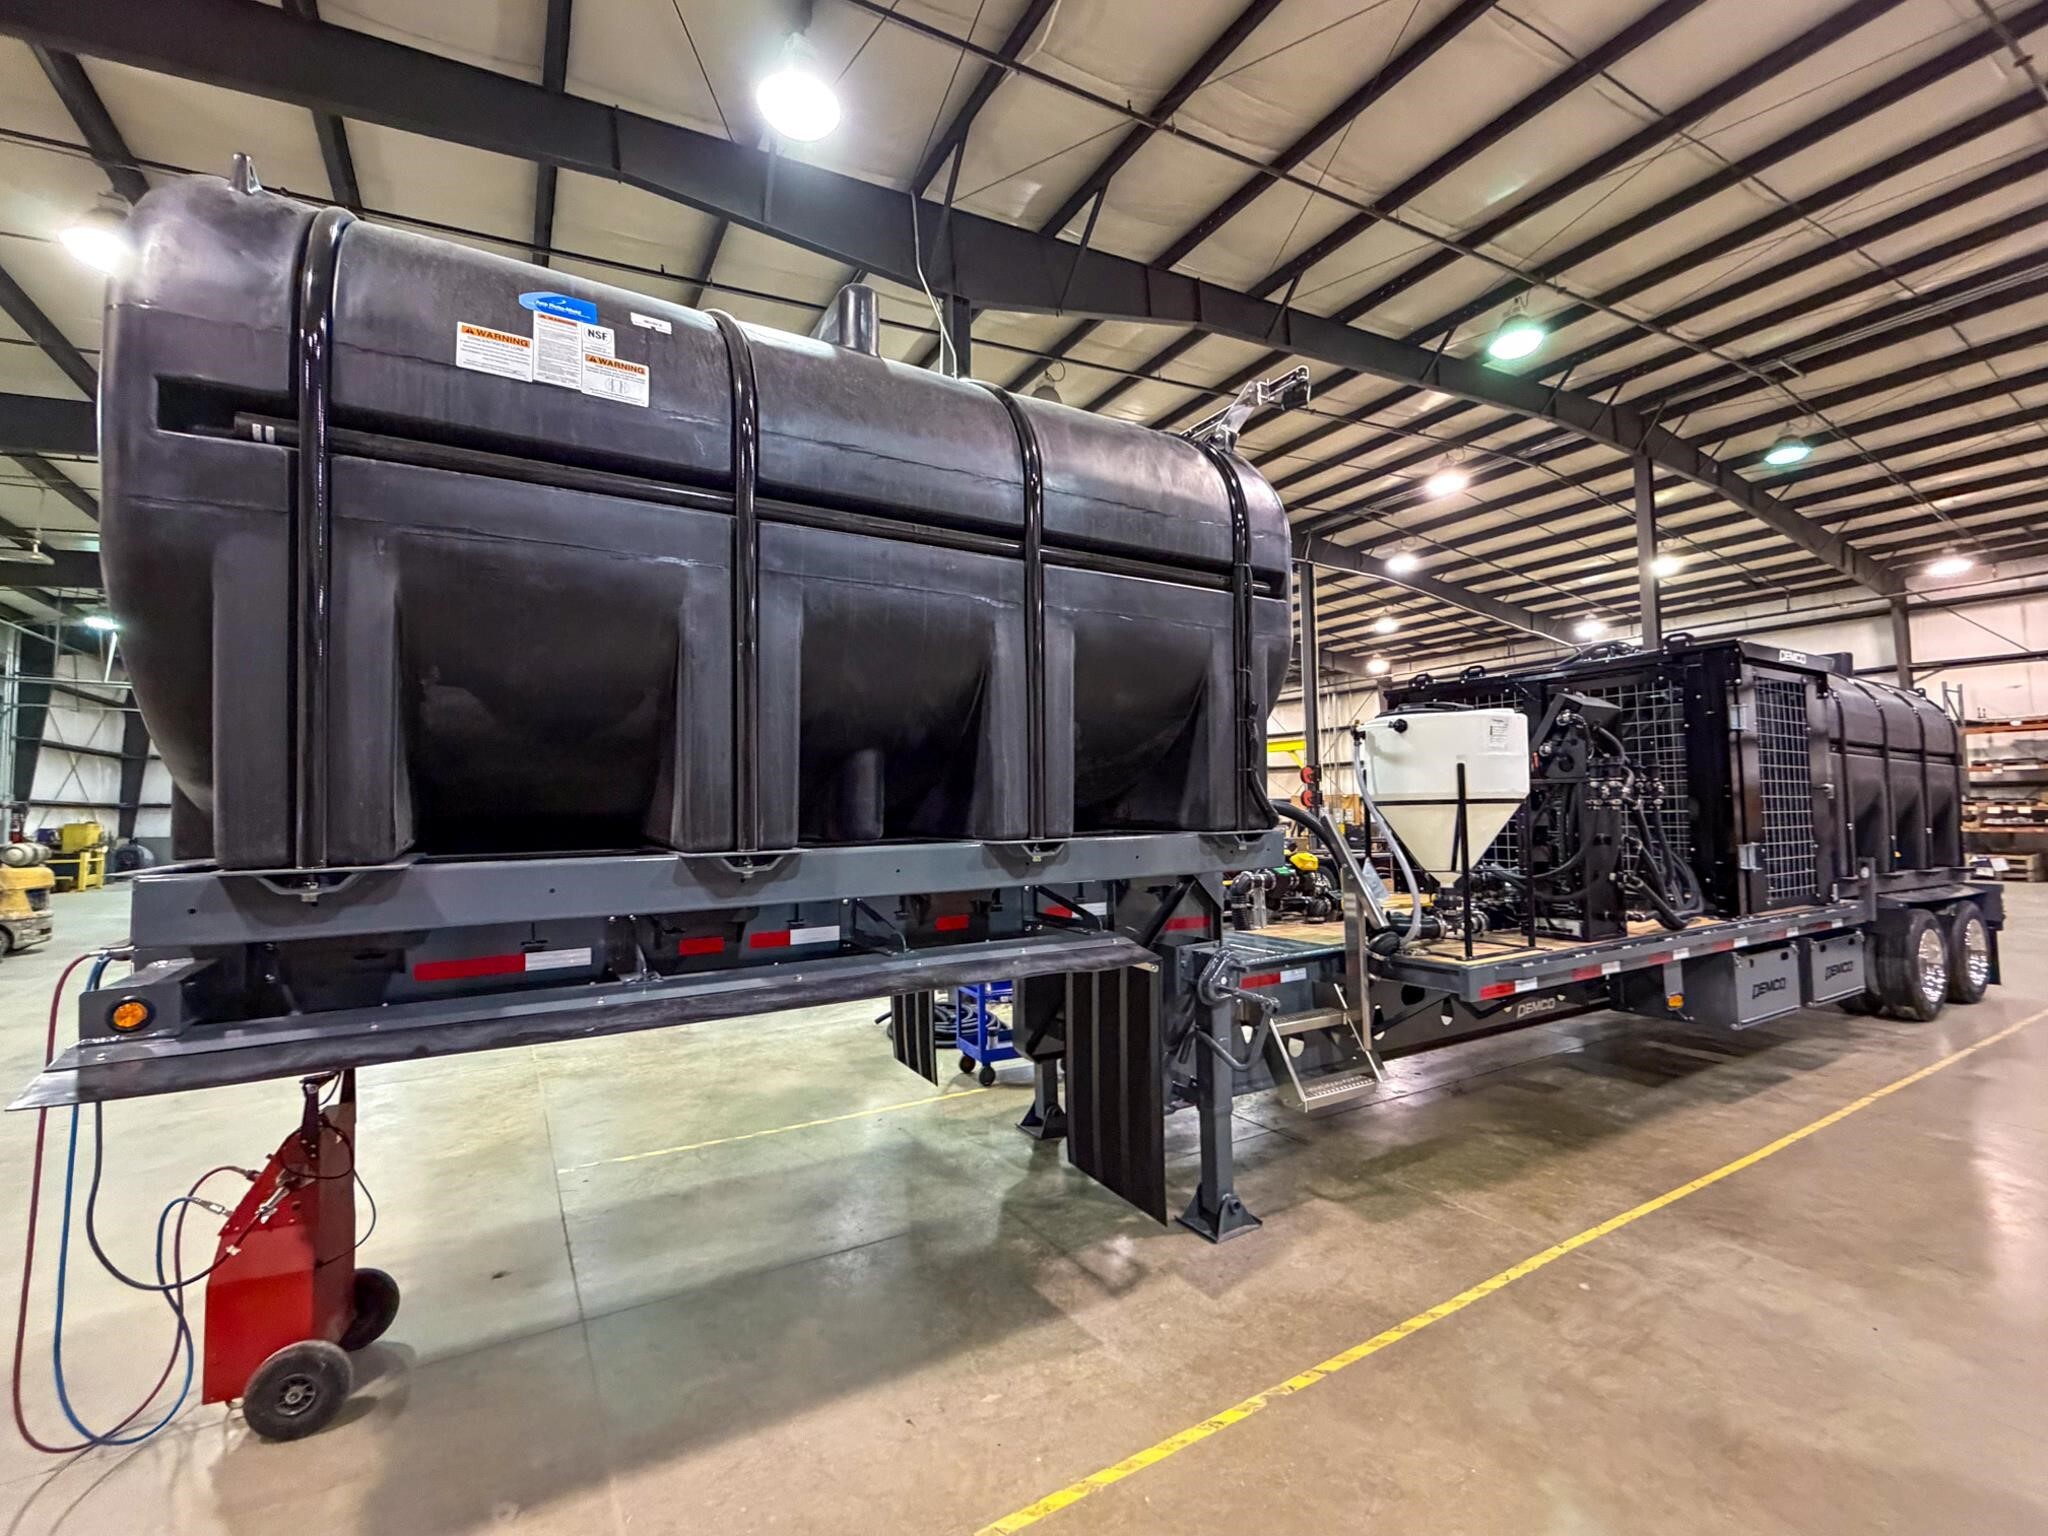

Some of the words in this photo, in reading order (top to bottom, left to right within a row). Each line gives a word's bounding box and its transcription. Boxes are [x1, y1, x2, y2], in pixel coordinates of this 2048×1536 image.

[475, 328, 530, 348] WARNING
[587, 328, 608, 341] NSF
[597, 357, 645, 375] WARNING
[1779, 650, 1807, 664] DEMCO
[1826, 961, 1853, 981] DEMCO
[1752, 977, 1786, 1000] DEMCO
[1517, 998, 1555, 1019] DEMCO
